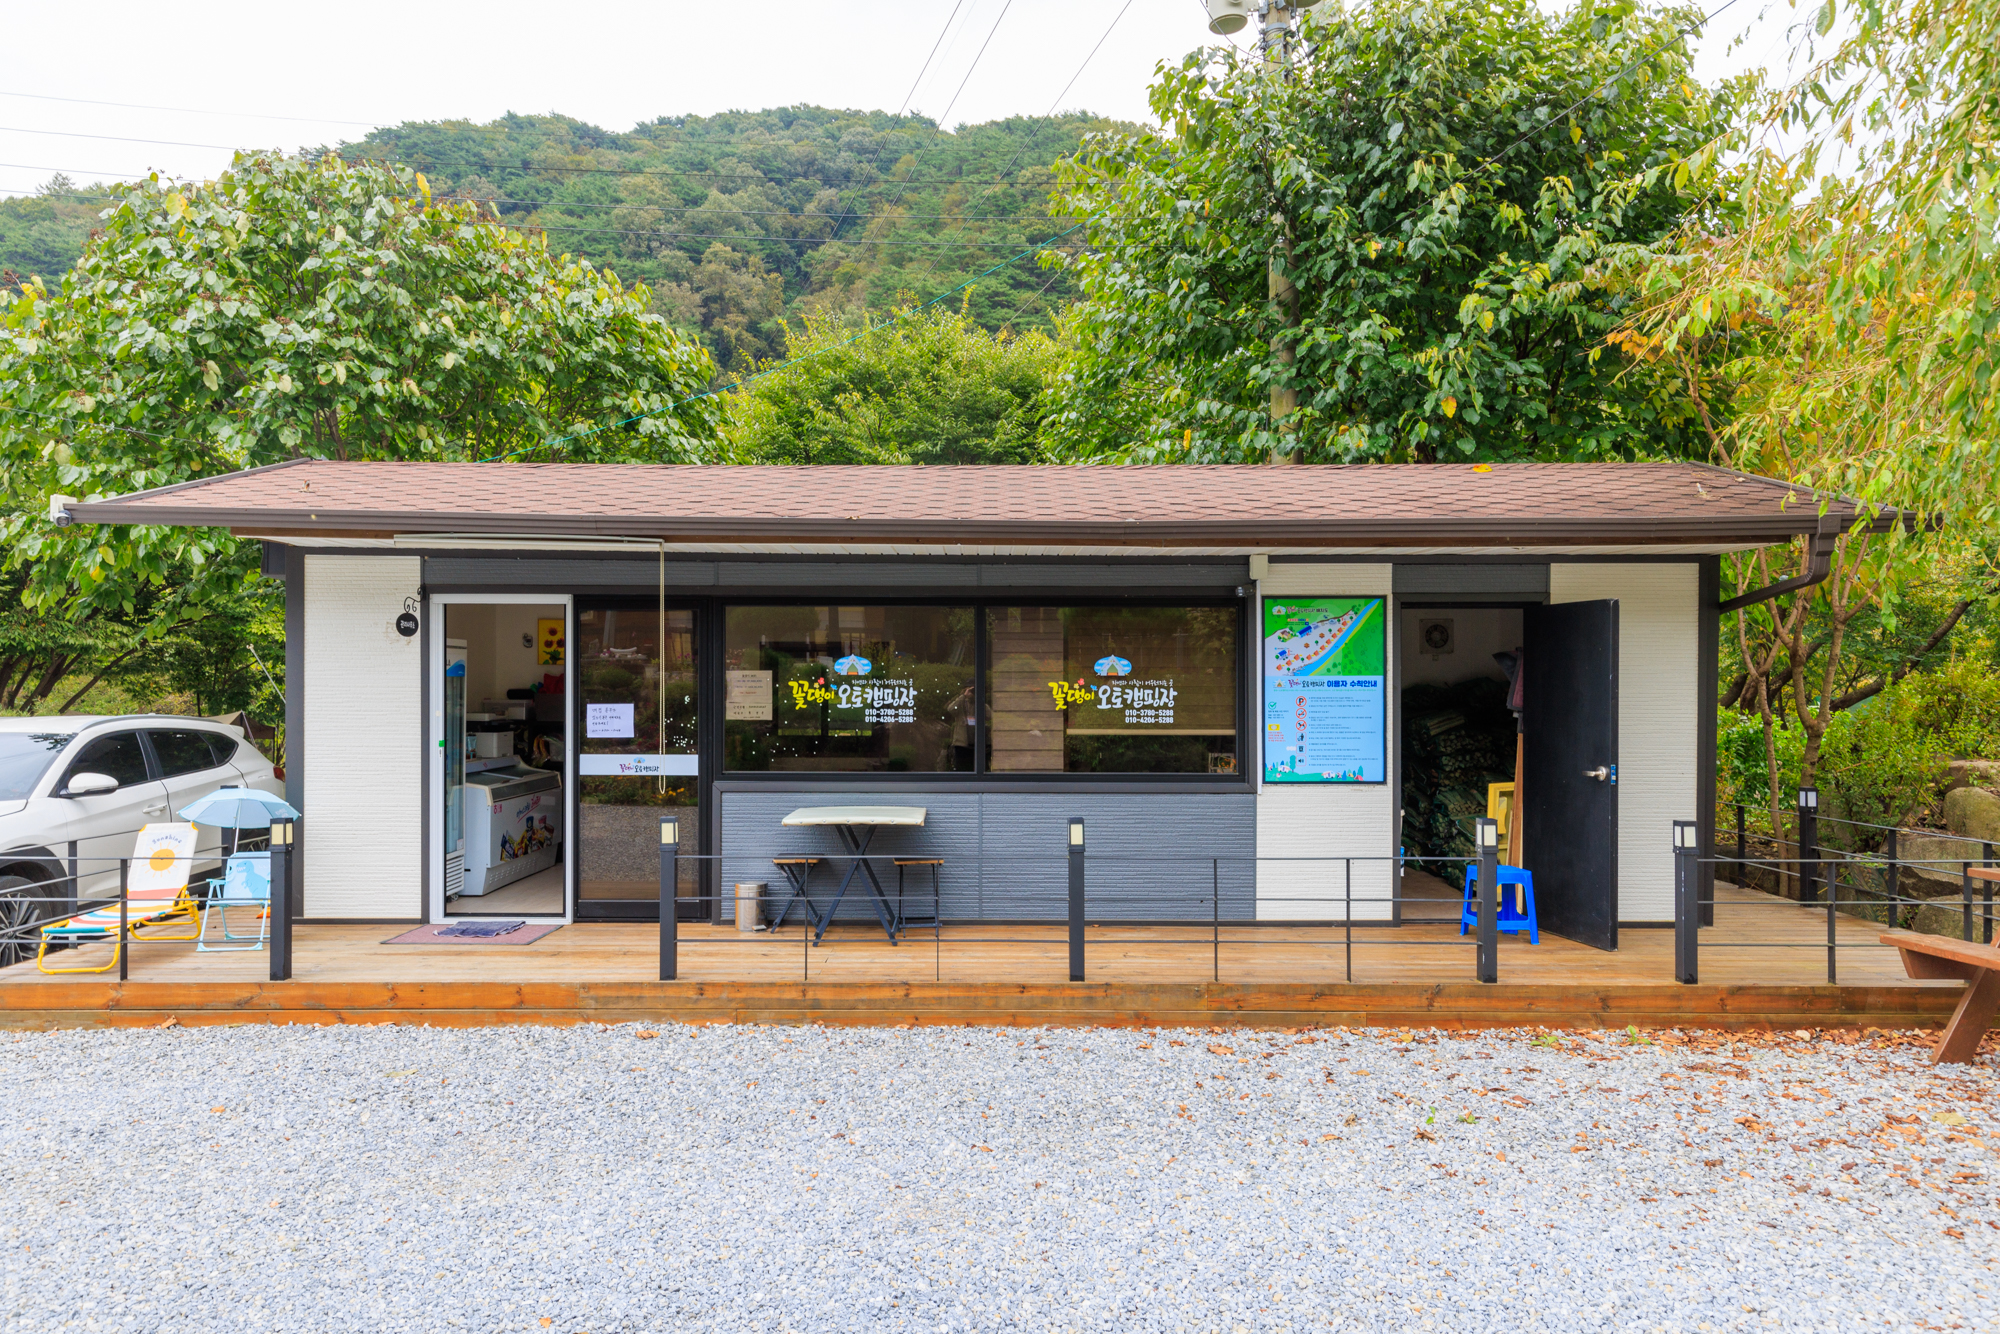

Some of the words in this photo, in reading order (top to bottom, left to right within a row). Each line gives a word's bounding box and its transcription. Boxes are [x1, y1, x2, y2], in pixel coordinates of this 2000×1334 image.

[909, 678, 913, 686] 곳
[1169, 678, 1173, 686] 곳
[1327, 680, 1347, 688] 이용자
[1350, 680, 1377, 688] 수칙안내
[788, 680, 835, 710] 꽃댕이
[837, 684, 917, 709] 오토캠핑장
[1048, 681, 1095, 711] 꽃댕이
[1097, 685, 1178, 709] 오토캠핑장
[635, 765, 659, 773] 오토캠핑장
[152, 834, 182, 844] Sunshine
